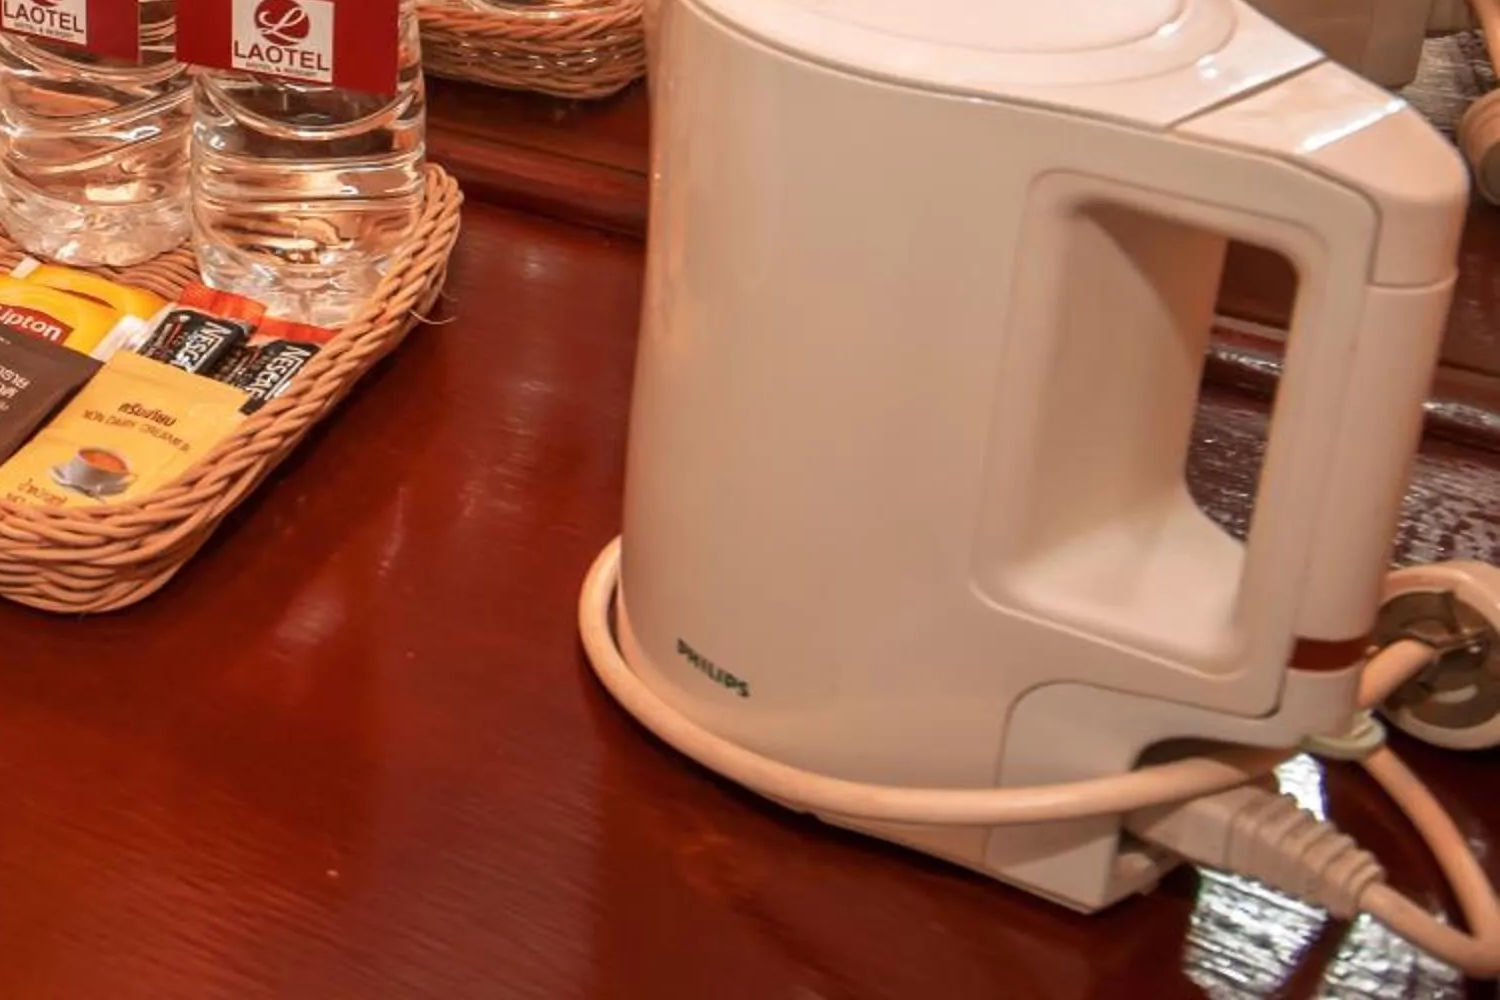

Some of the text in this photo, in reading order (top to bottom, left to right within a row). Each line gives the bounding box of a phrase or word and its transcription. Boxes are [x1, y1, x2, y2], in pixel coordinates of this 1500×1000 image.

[3, 0, 85, 34] LAOTEL
[234, 40, 331, 72] LAOTEL
[677, 637, 750, 698] PHILIPS
